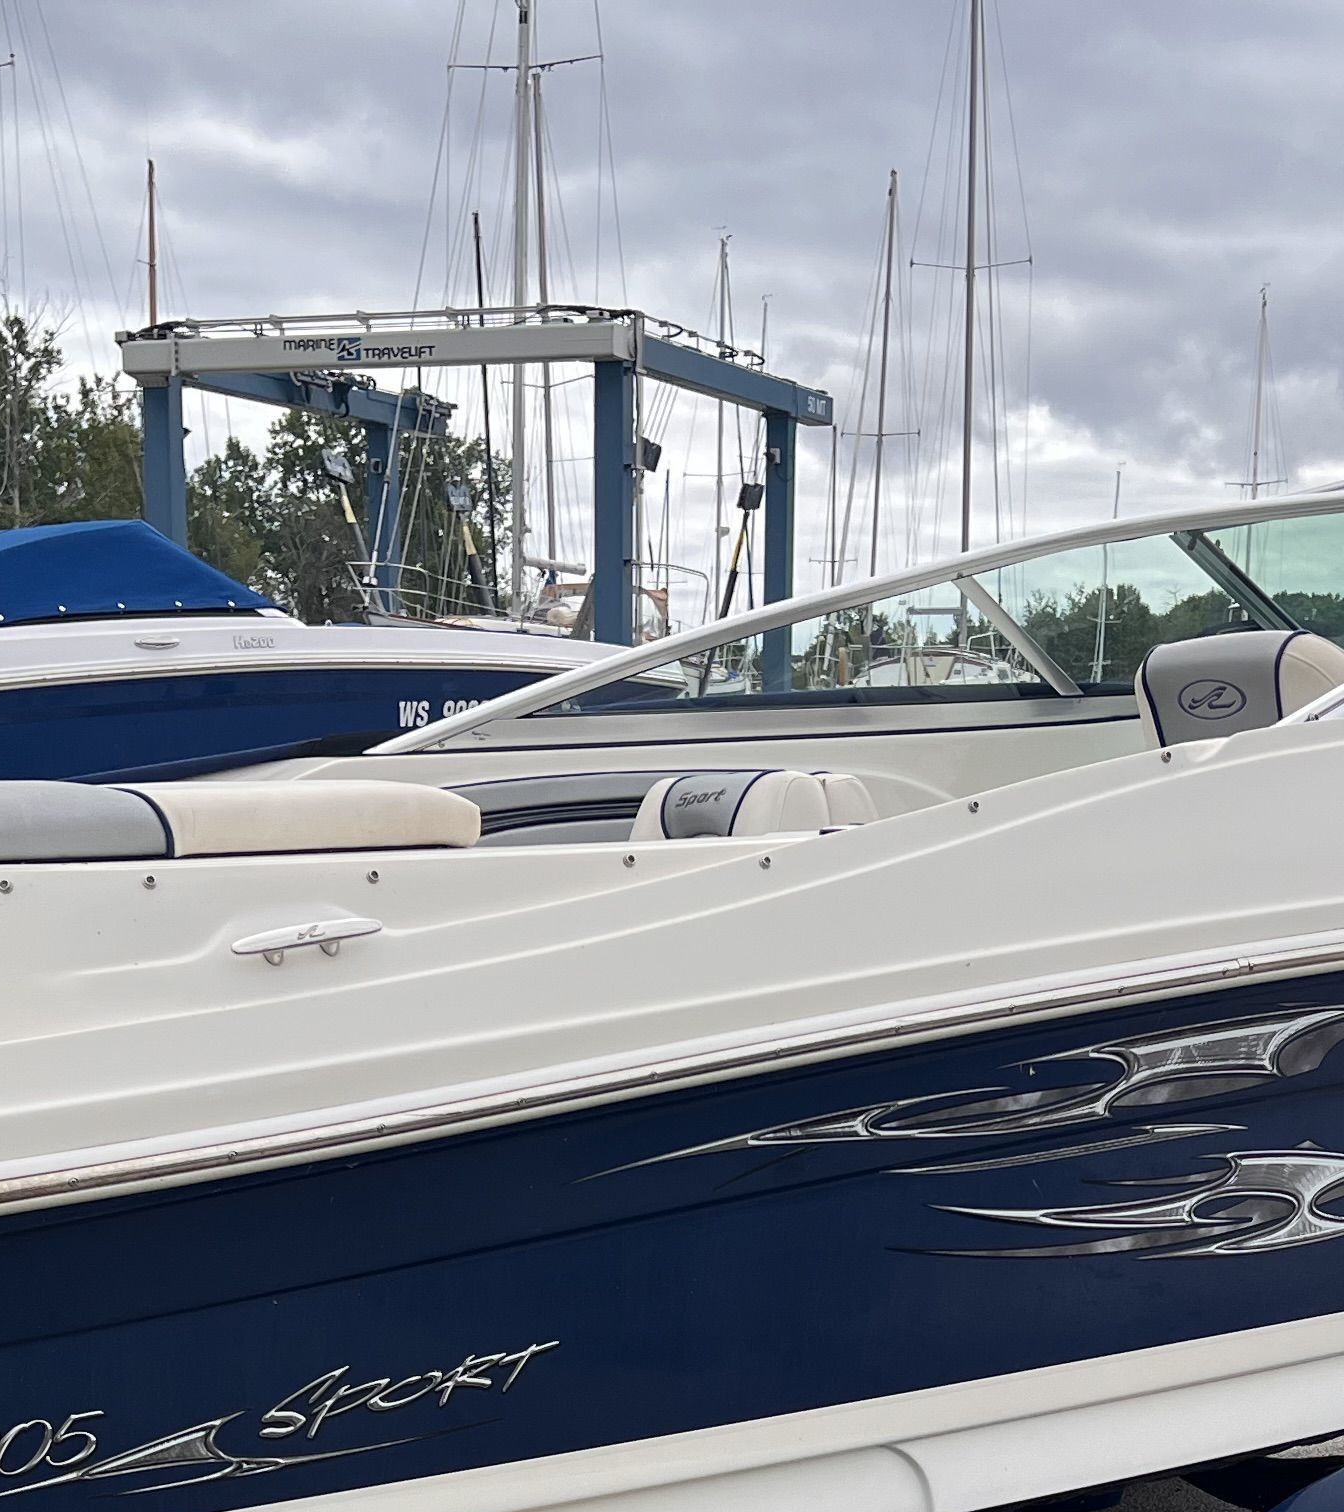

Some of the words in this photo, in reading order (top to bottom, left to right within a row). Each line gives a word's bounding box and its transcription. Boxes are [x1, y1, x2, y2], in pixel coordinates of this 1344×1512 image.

[283, 338, 336, 352] MARINE
[363, 345, 436, 360] TRAVELIFT
[398, 700, 430, 728] WS
[675, 787, 727, 808] Sport
